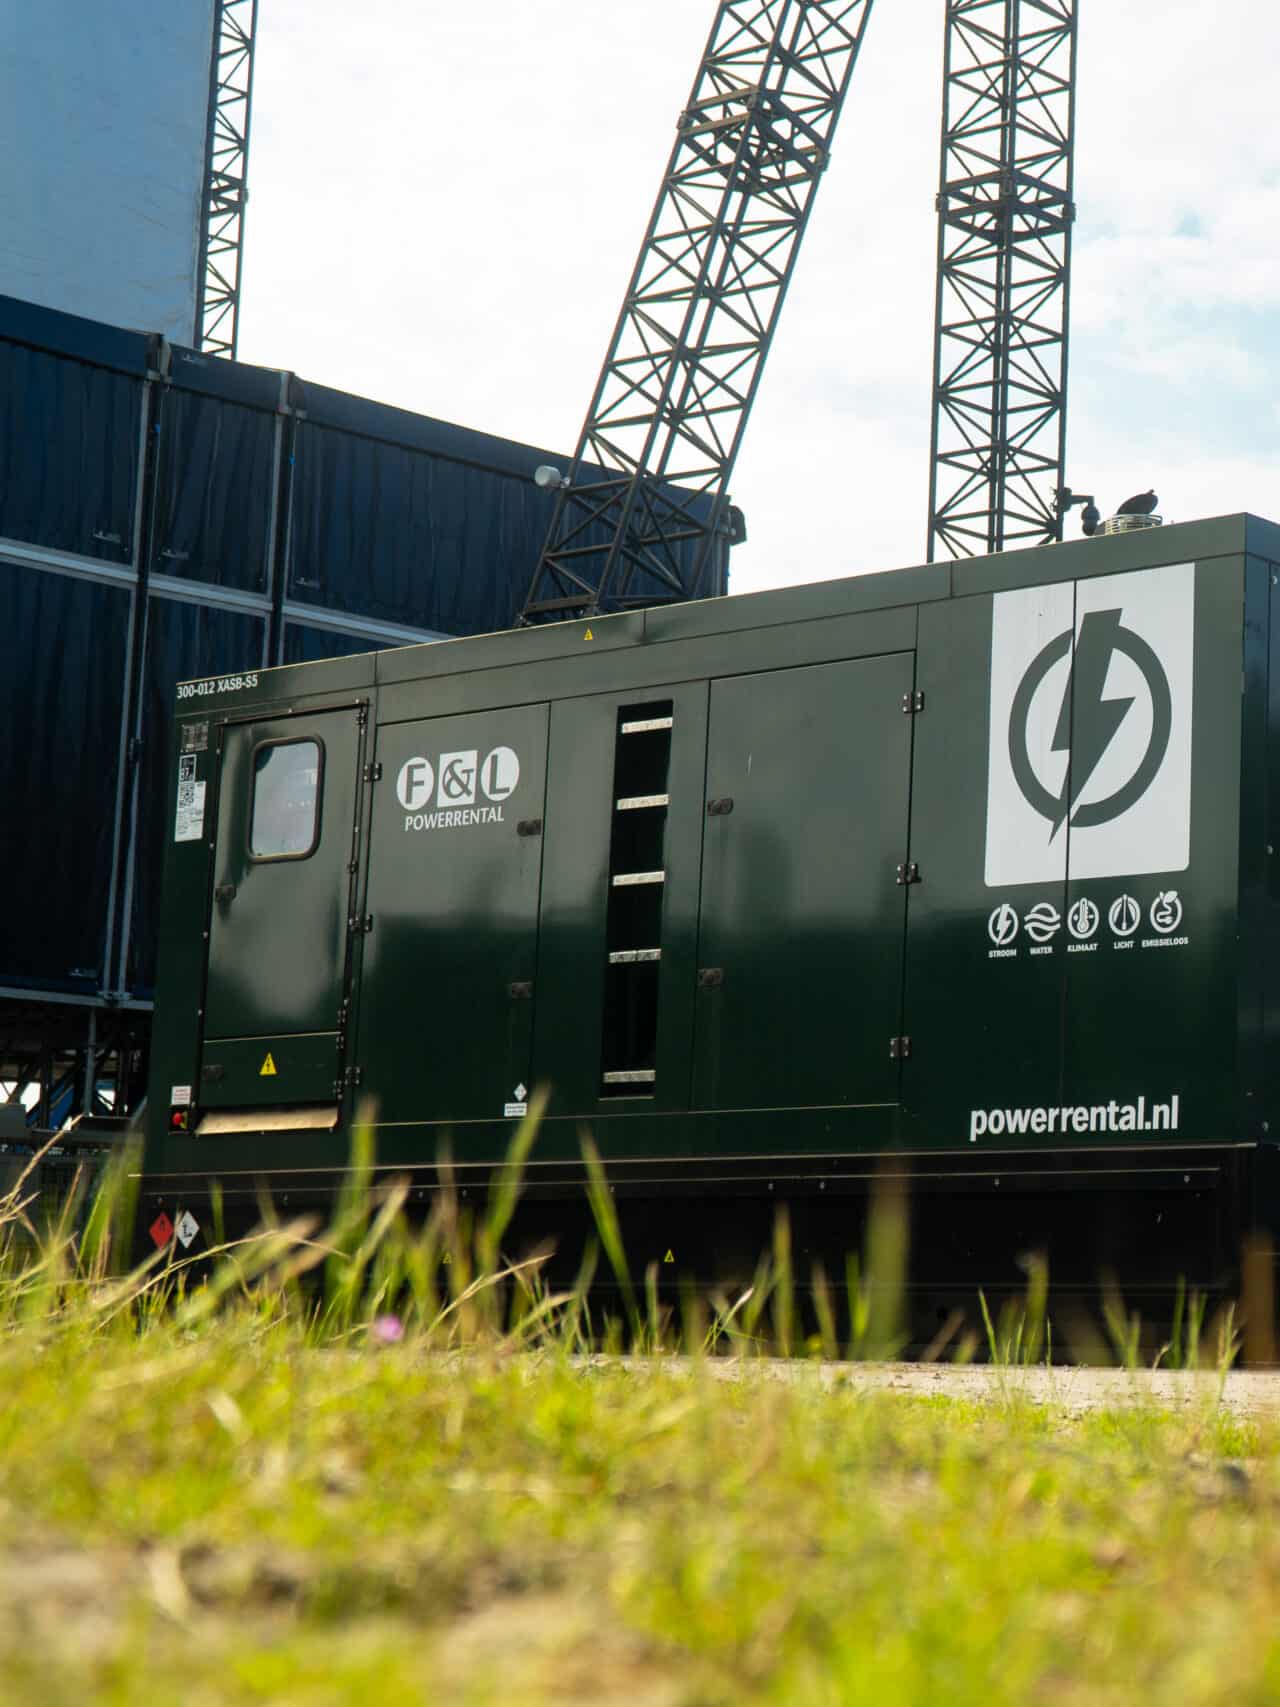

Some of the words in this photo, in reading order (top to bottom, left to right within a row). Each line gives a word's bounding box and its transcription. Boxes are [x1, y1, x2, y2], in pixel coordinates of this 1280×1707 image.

[176, 681, 215, 699] 300-012
[217, 674, 258, 693] XASB-S5
[402, 750, 514, 807] F&L
[404, 806, 505, 832] POWERRENTAL
[1030, 946, 1053, 955] WATER
[1067, 943, 1098, 953] KLIMAAT
[1113, 940, 1135, 950] LICHT
[970, 1095, 1179, 1142] powerrental.nl
